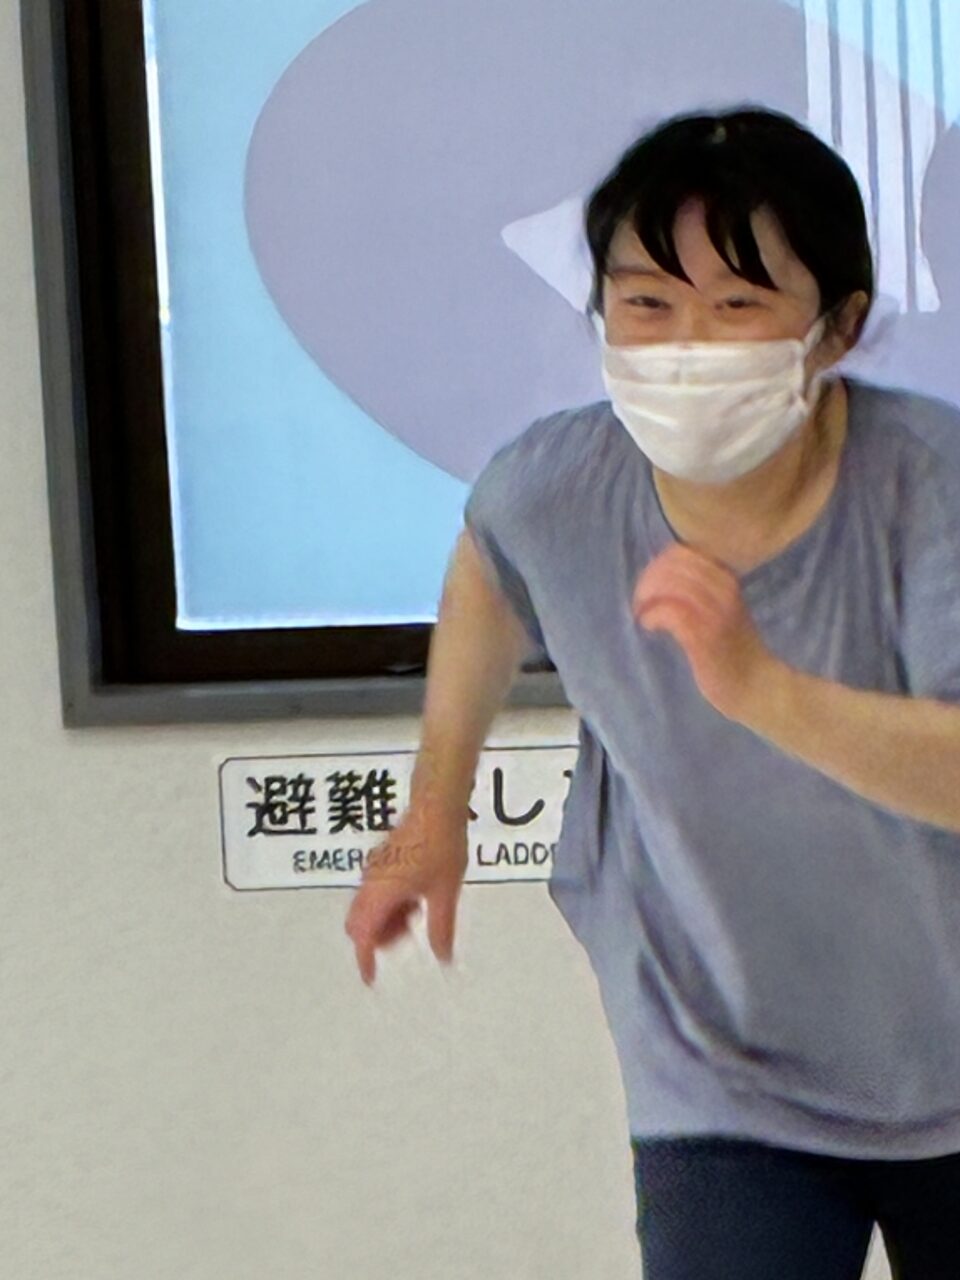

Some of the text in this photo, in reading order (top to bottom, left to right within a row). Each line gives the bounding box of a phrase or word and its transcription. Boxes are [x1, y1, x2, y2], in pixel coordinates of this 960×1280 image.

[246, 766, 573, 838] 避難し
[477, 842, 558, 866] LADD
